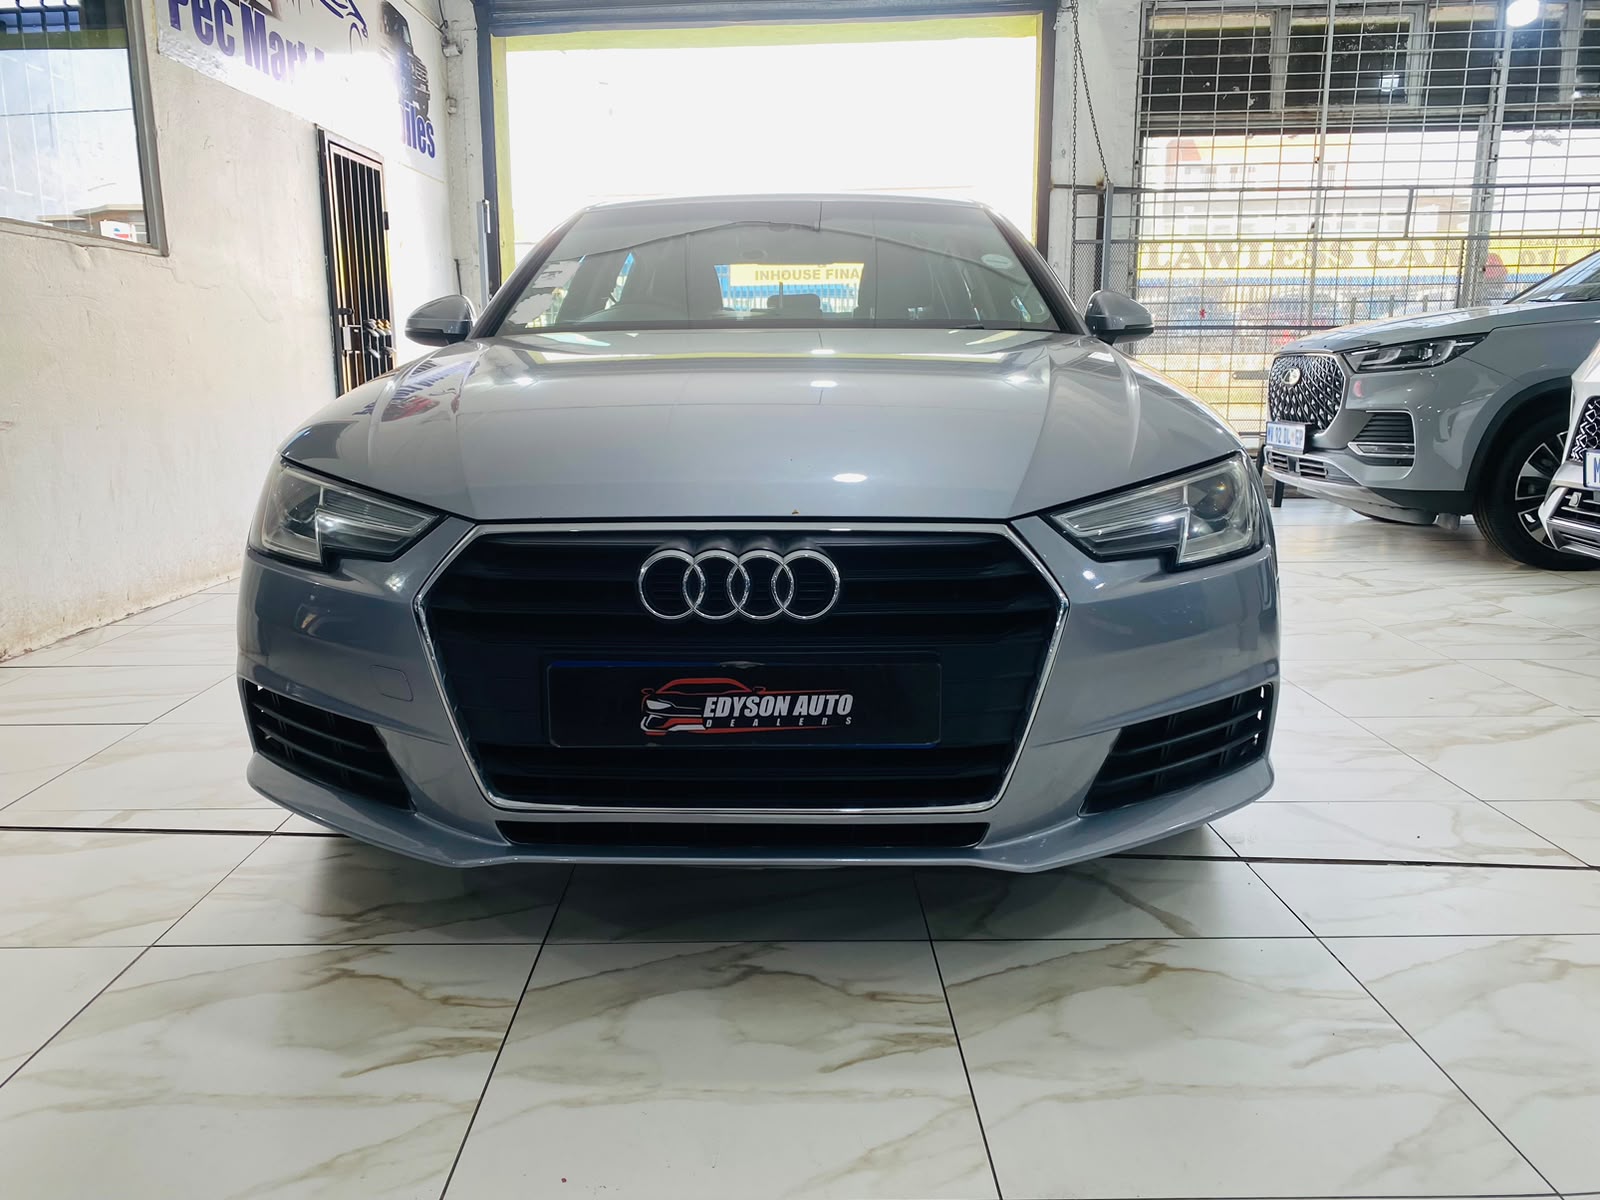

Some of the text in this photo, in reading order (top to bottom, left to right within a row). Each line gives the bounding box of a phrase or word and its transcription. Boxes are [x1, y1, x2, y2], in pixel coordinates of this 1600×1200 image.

[754, 268, 821, 281] INHOUSE
[703, 693, 854, 717] EDYSON AUTO
[706, 716, 852, 728] DEALERS
